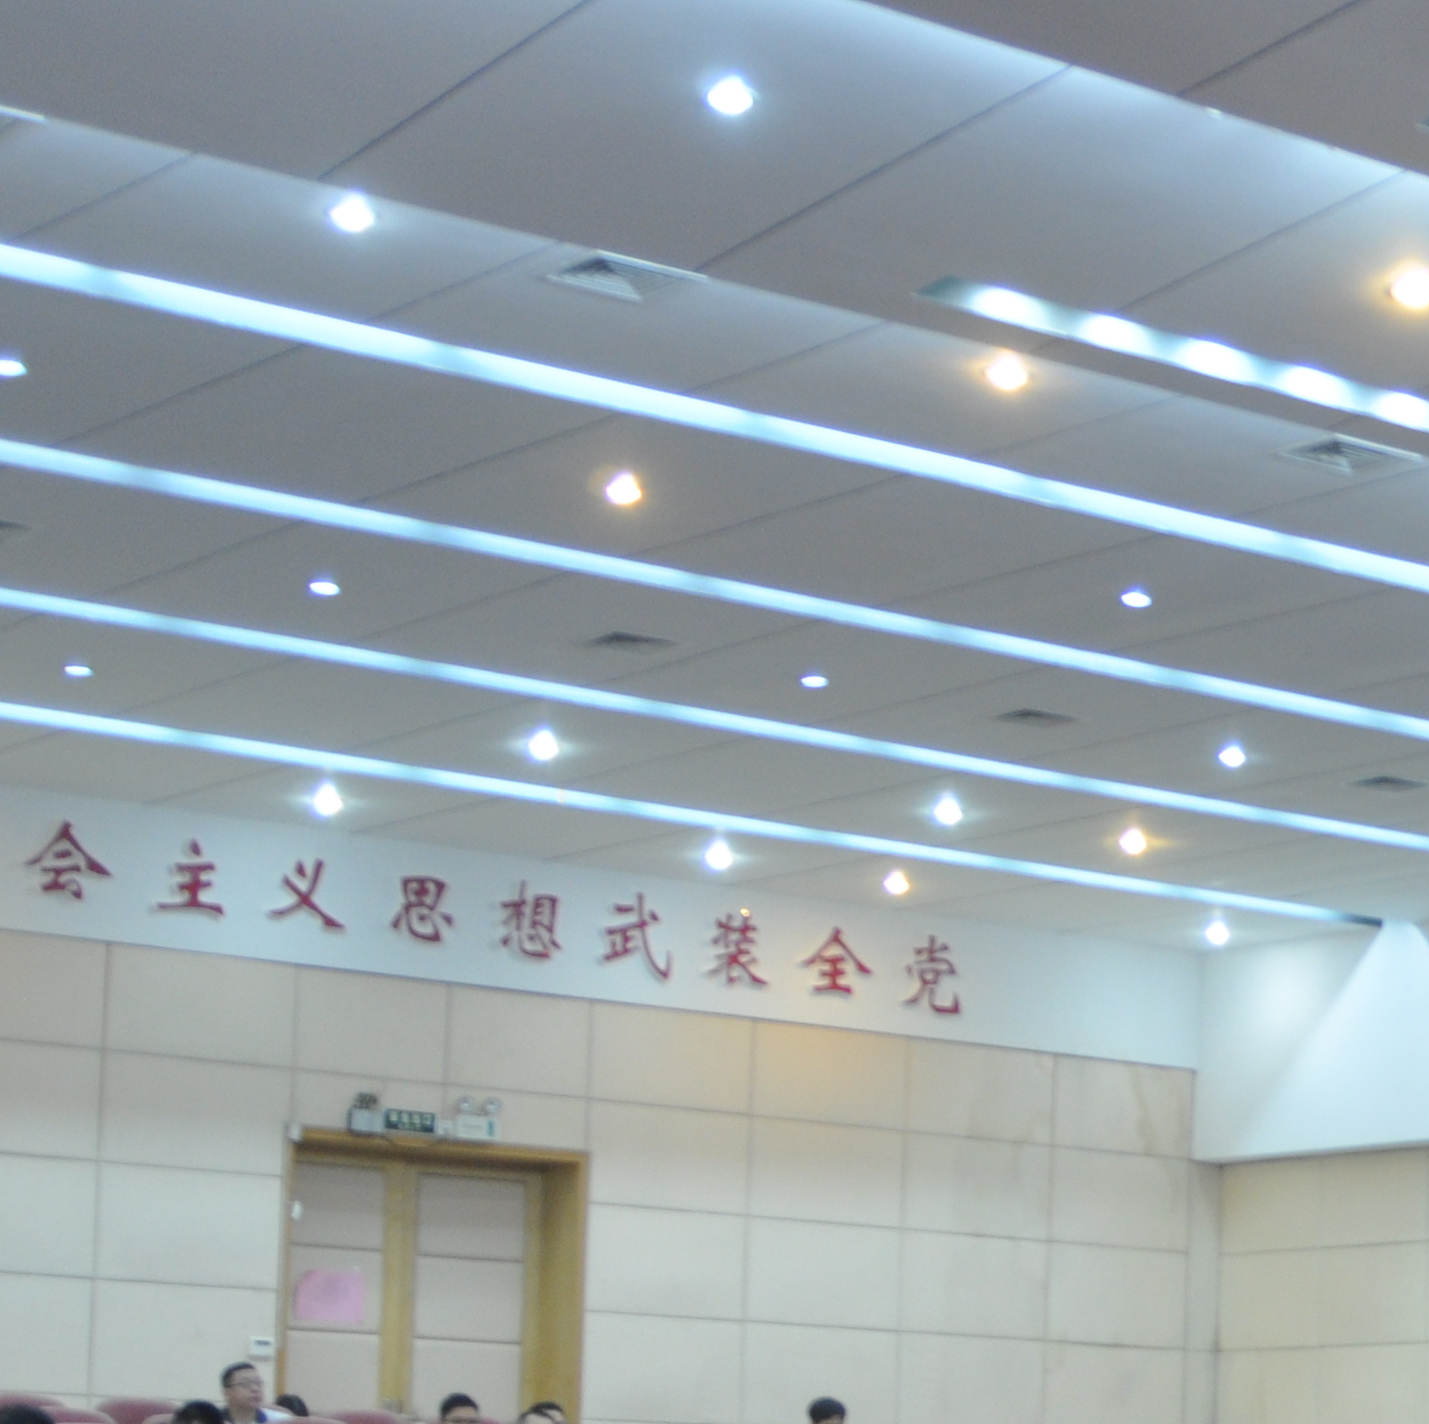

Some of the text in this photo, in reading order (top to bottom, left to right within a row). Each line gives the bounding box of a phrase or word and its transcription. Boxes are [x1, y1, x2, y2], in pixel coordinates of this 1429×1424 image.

[25, 821, 962, 1015] 会主义思想武装全党
